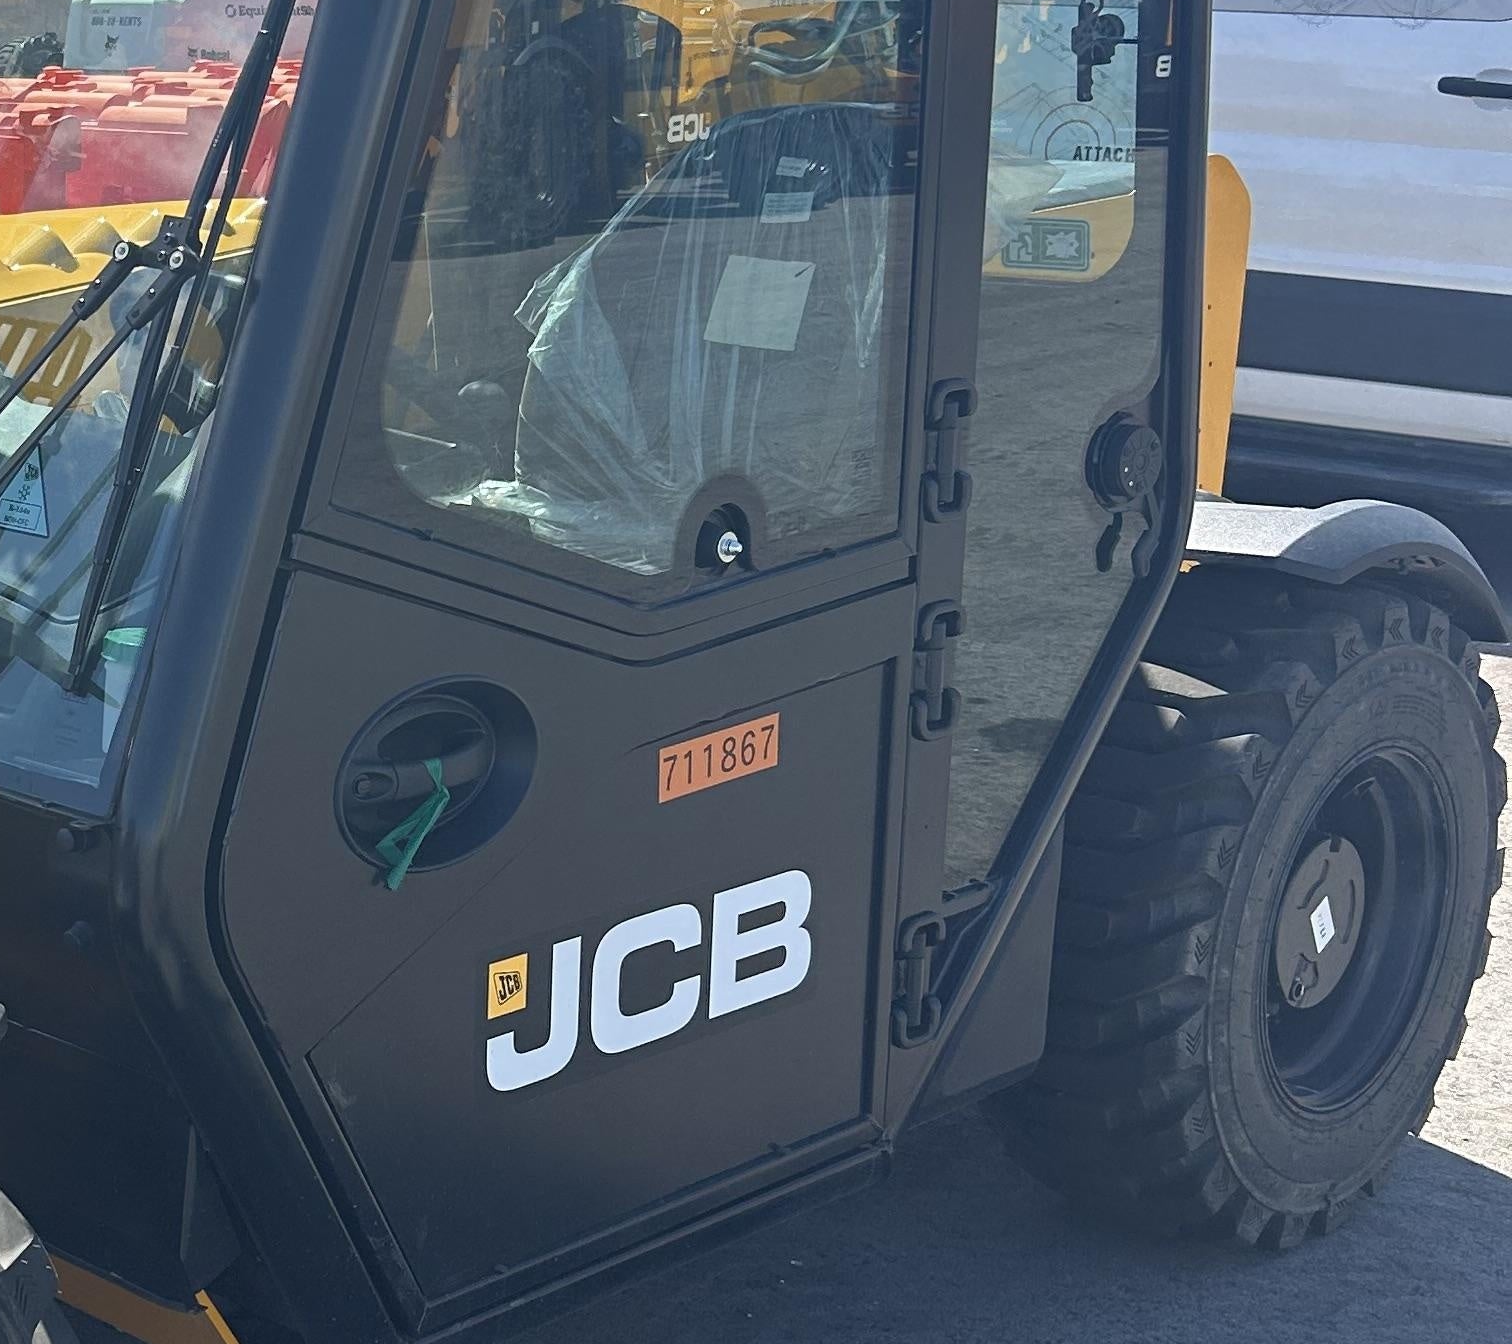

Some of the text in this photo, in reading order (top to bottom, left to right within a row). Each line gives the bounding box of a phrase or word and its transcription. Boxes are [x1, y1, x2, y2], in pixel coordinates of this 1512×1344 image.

[662, 724, 775, 792] 711867
[486, 869, 812, 1093] JCB
[498, 974, 521, 1001] JCB
